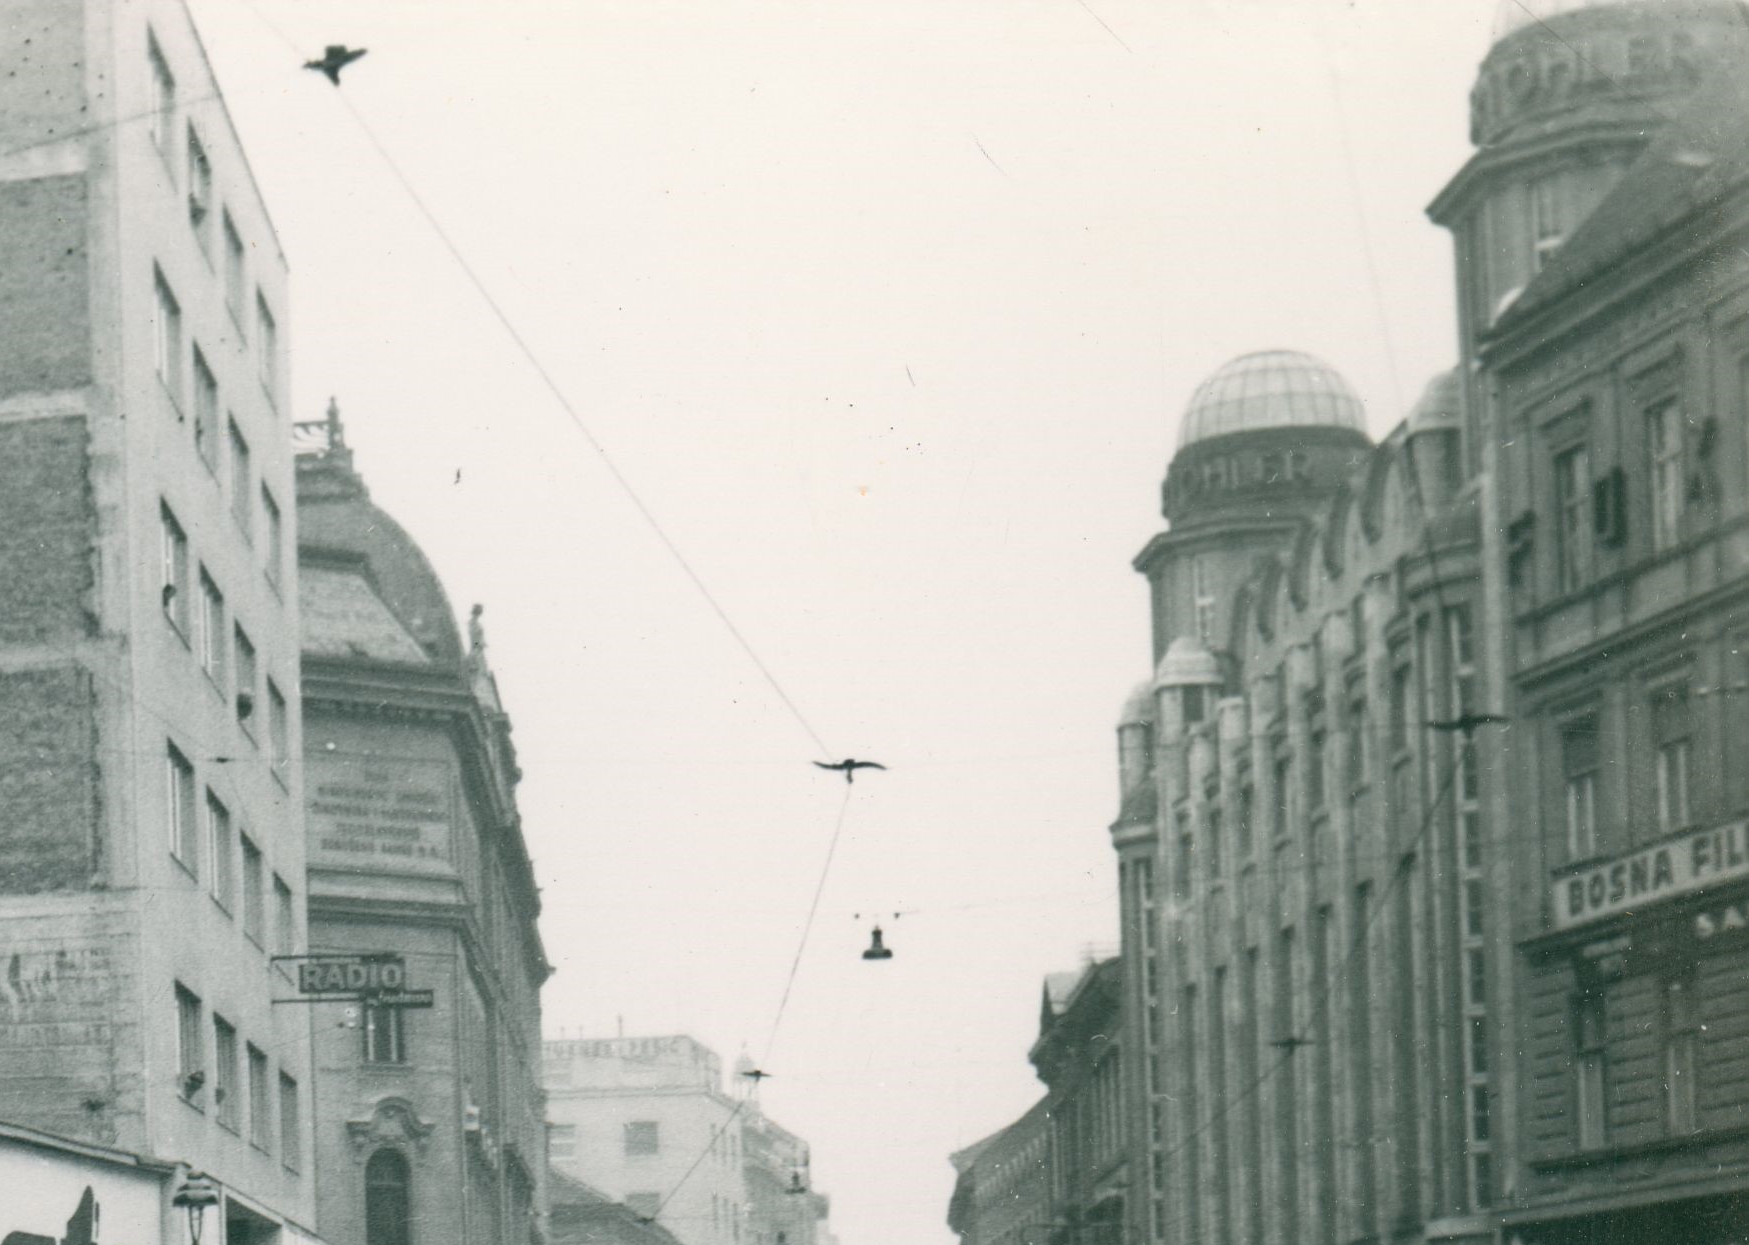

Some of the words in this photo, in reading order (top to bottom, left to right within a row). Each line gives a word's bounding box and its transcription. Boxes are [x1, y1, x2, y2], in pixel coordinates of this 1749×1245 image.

[1568, 848, 1675, 917] BOSNA
[1691, 823, 1749, 877] FIL
[303, 963, 402, 990] RADIO
